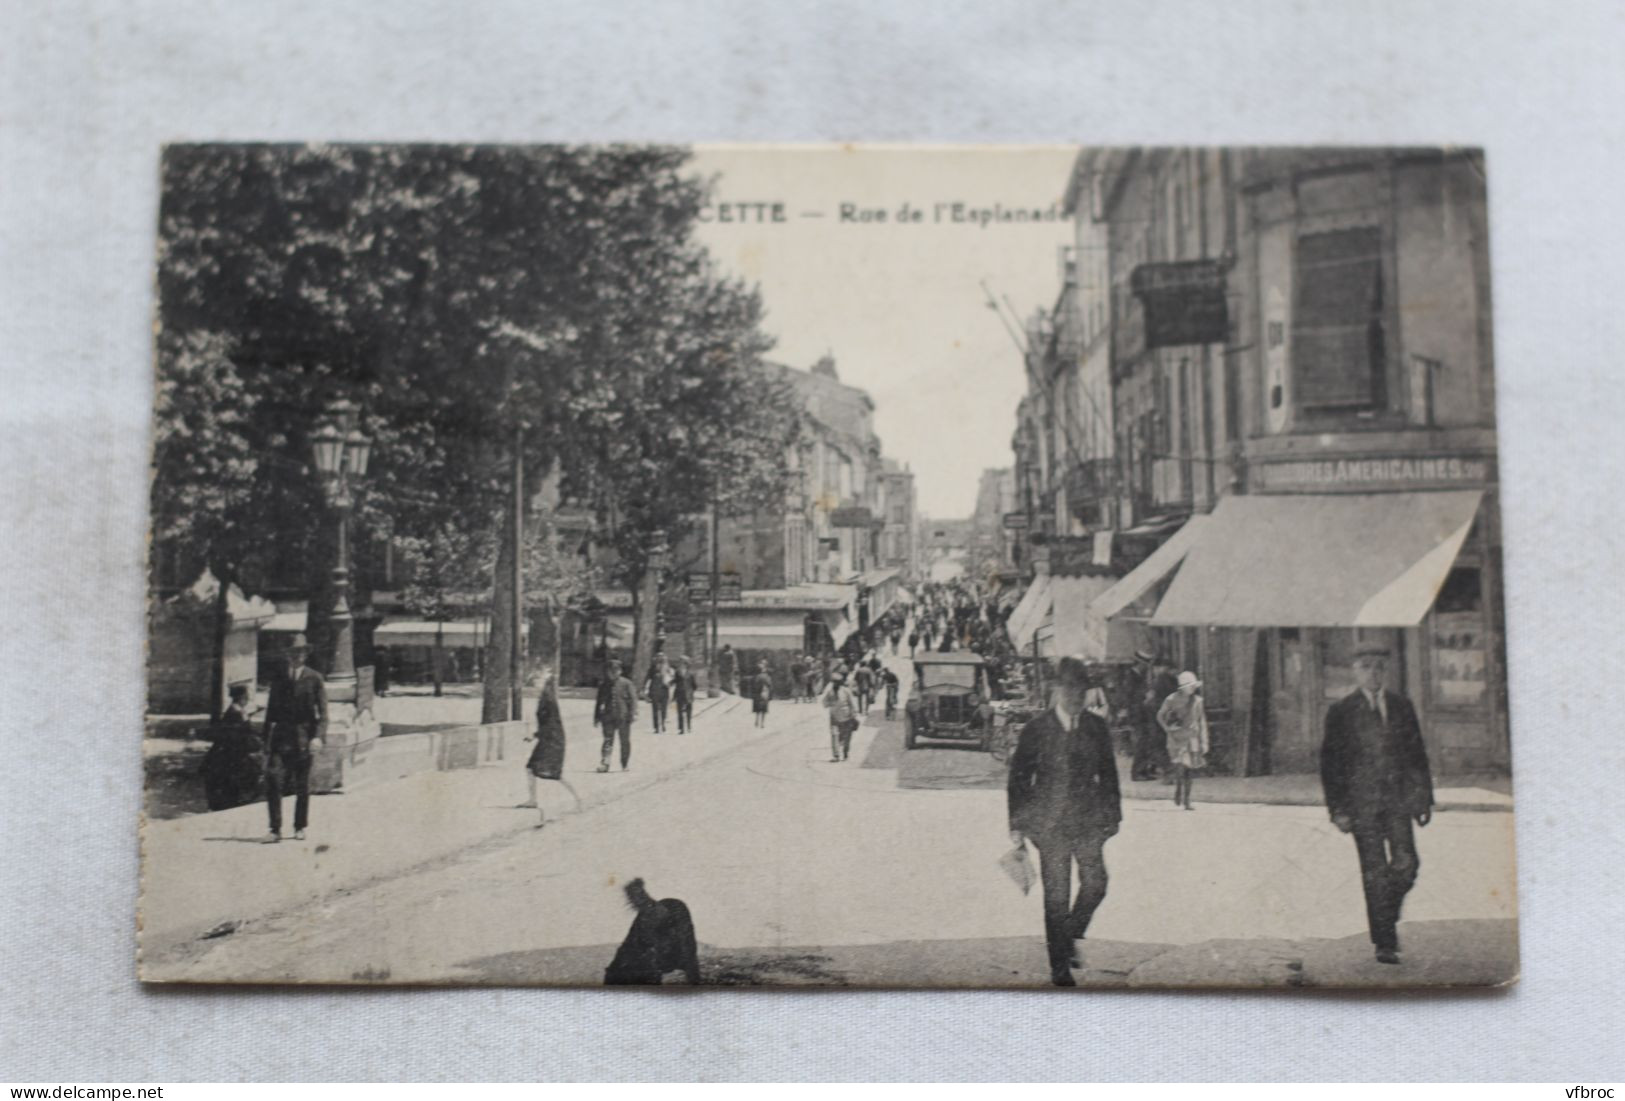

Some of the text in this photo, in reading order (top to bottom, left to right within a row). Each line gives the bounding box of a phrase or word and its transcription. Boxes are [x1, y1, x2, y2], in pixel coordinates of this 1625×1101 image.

[697, 202, 787, 223] CETTE
[839, 202, 887, 223] Rue
[896, 202, 923, 223] de
